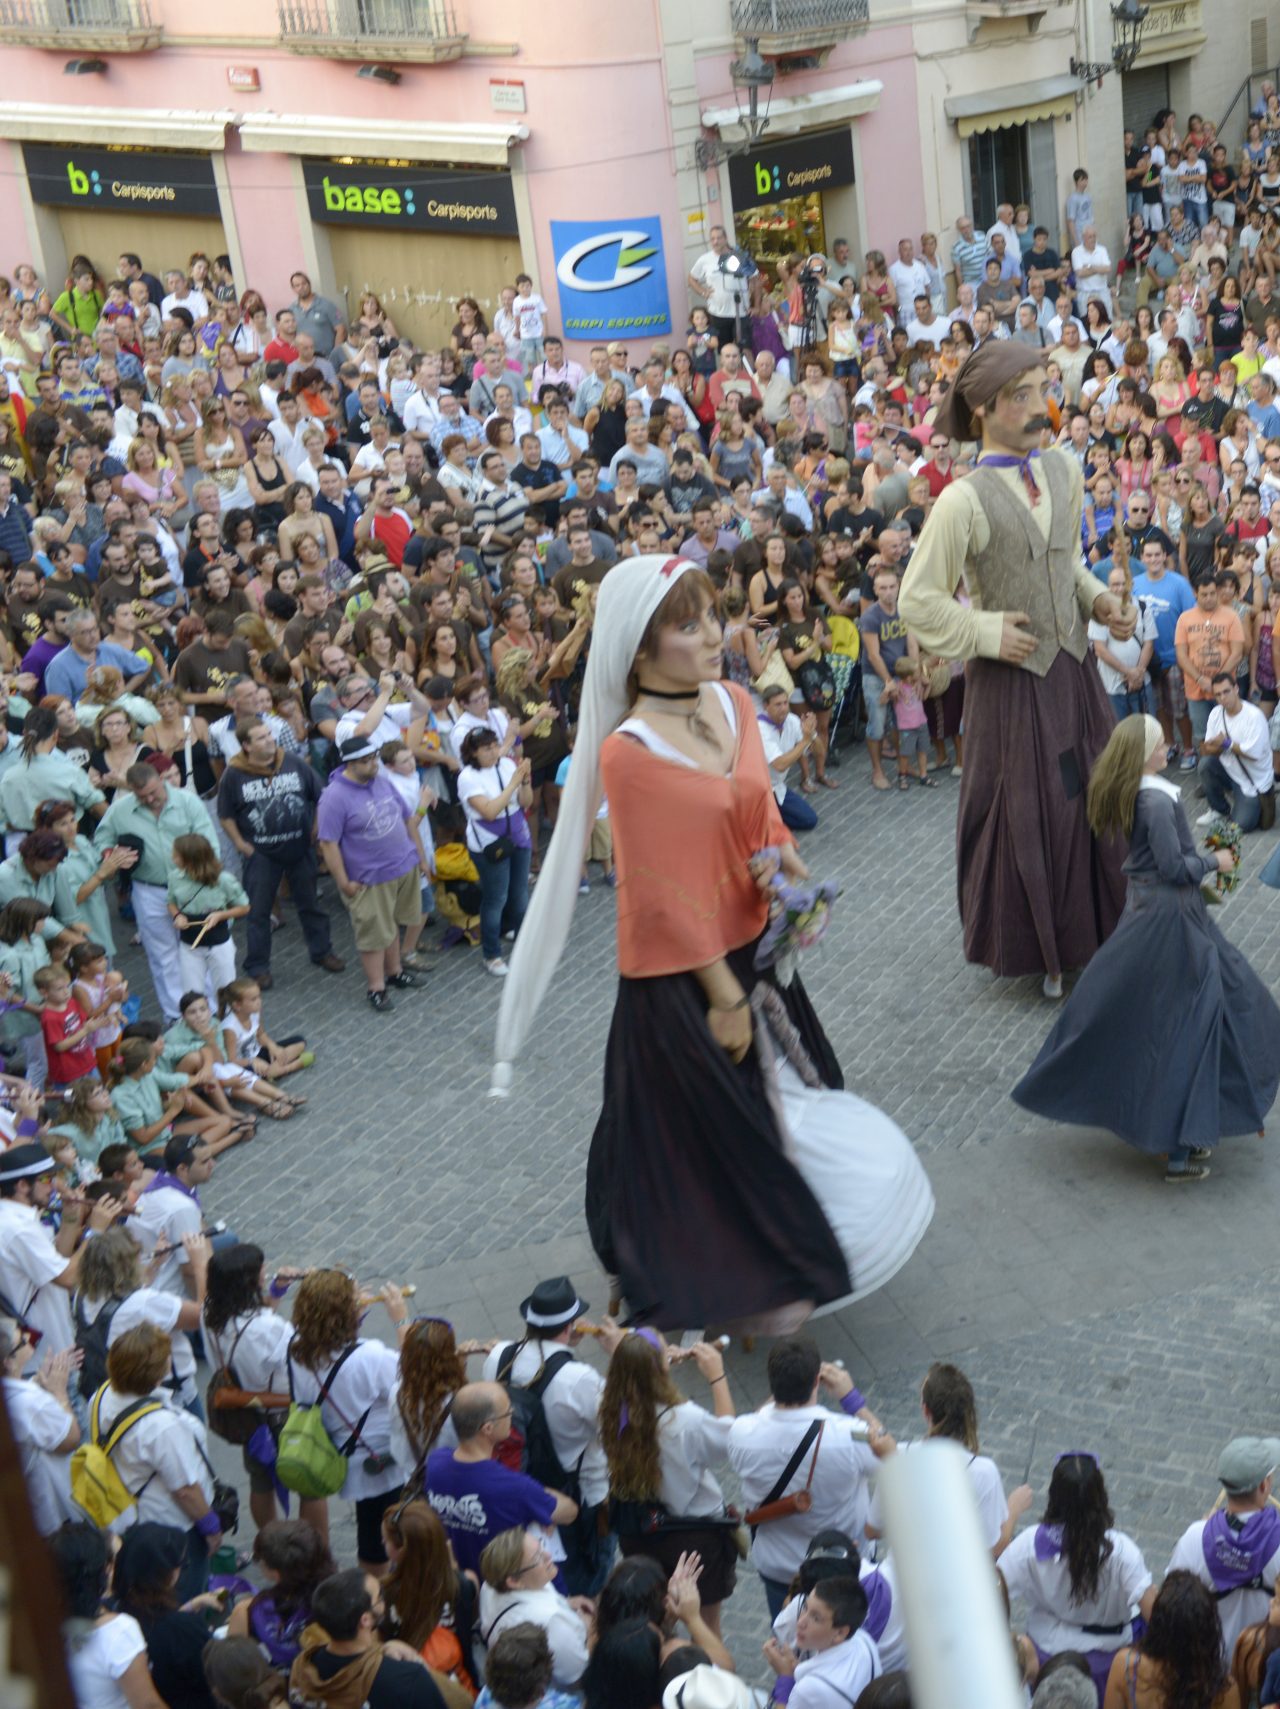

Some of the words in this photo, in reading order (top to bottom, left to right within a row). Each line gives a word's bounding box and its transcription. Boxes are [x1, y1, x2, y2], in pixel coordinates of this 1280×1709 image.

[787, 164, 832, 187] Carpisports
[112, 181, 175, 201] Carpisports
[427, 200, 498, 221] Carpisports
